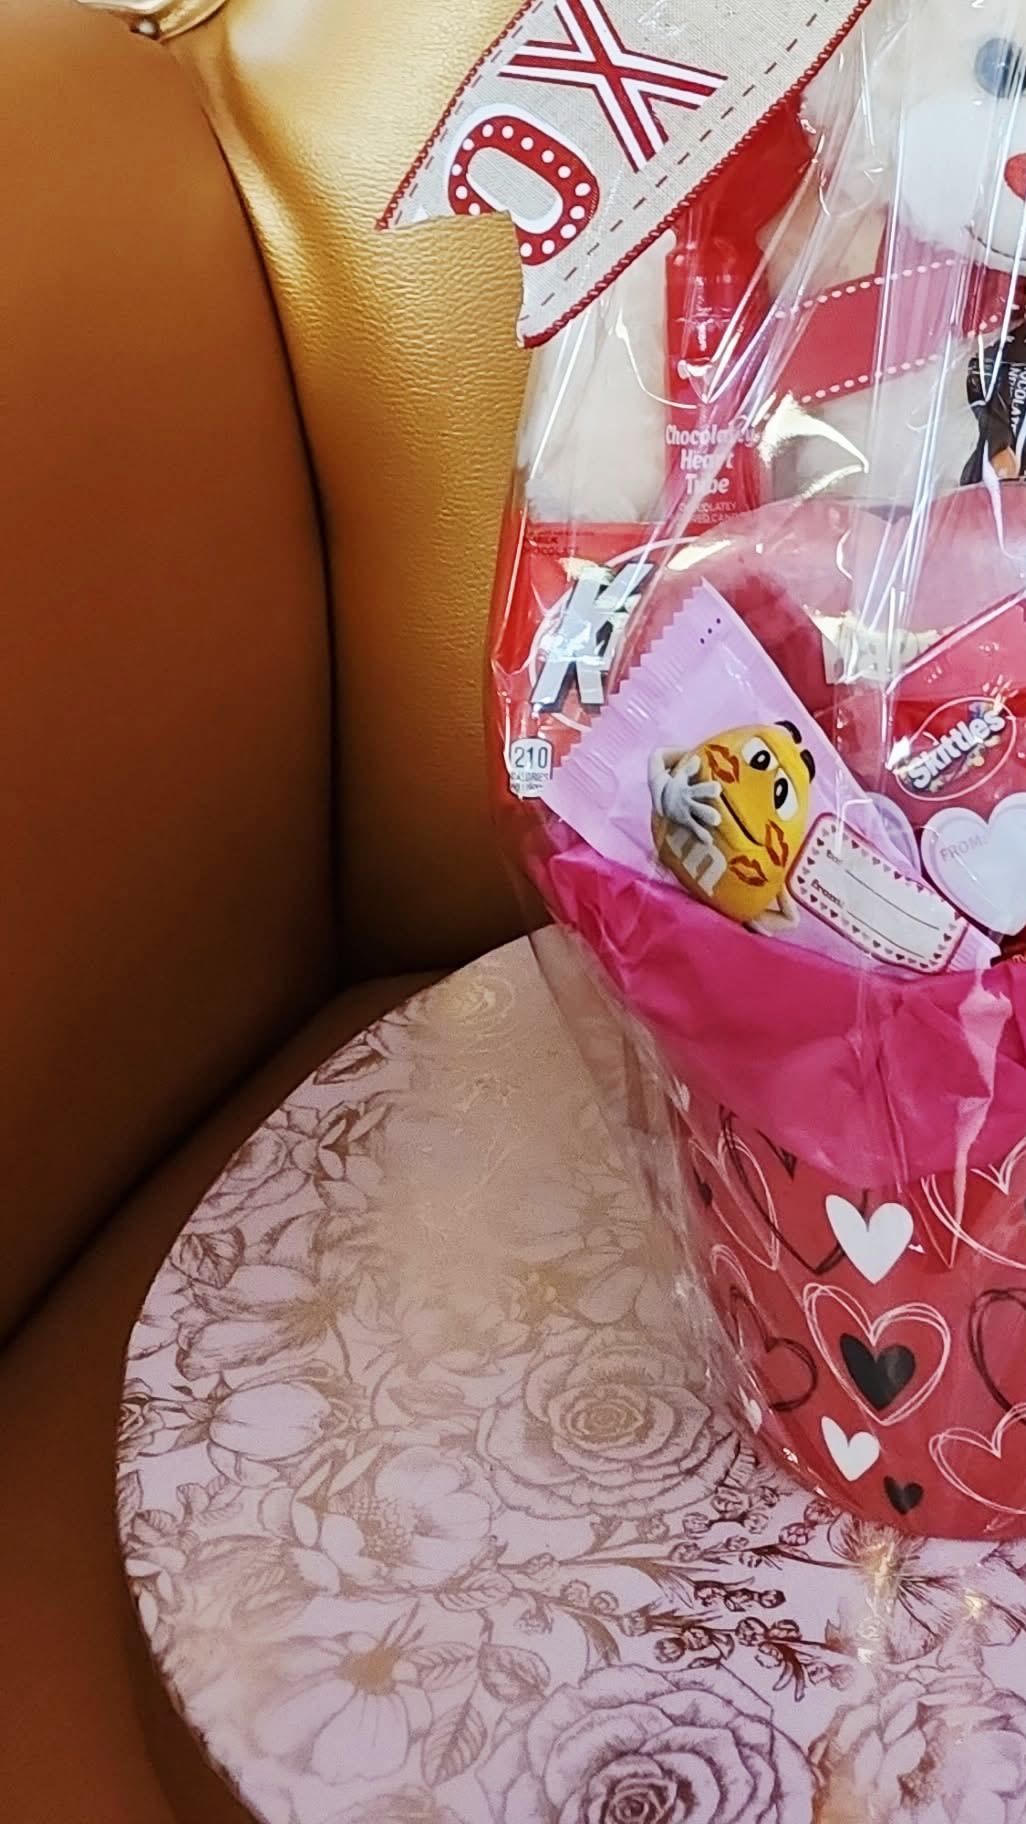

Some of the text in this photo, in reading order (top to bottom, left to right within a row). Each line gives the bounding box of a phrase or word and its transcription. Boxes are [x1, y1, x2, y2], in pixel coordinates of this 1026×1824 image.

[665, 424, 759, 447] Chocolay
[680, 448, 734, 470] Heat
[686, 473, 730, 494] Tbe
[515, 746, 548, 769] 210
[909, 709, 1008, 790] Skittles
